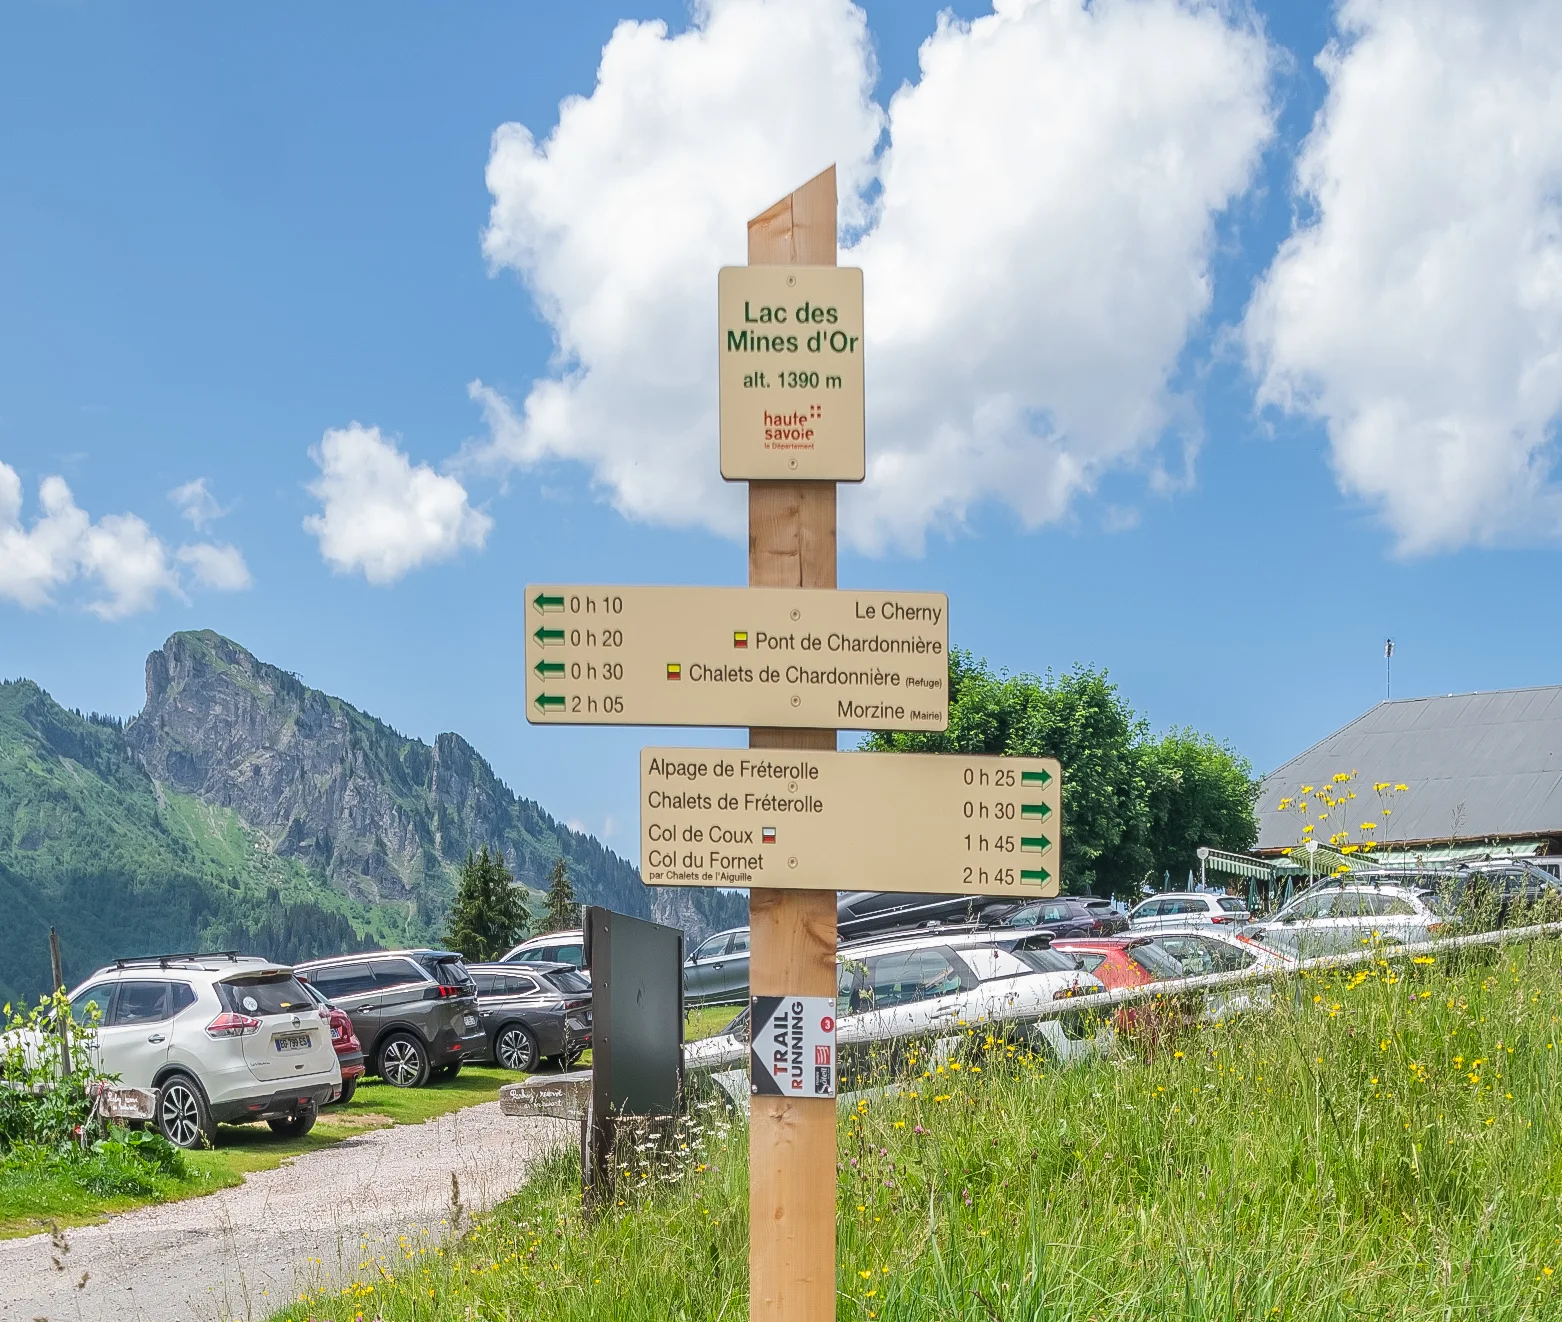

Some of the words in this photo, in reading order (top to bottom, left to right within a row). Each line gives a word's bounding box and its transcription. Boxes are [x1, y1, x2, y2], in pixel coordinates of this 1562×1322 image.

[745, 301, 787, 324] Lac
[795, 301, 838, 324] des
[727, 330, 798, 353] Mines
[807, 330, 859, 353] d'Or
[743, 371, 770, 389] alt.
[778, 372, 819, 389] 1390
[825, 375, 842, 389] m
[764, 409, 808, 426] haute
[764, 427, 814, 441] savoie
[764, 442, 770, 450] le
[570, 596, 581, 614] 0
[586, 596, 596, 614] h
[602, 596, 623, 614] 10
[855, 601, 876, 619] Le
[881, 602, 942, 626] Cherny
[570, 629, 581, 647] 0
[586, 629, 596, 647] h
[602, 629, 623, 647] 20
[756, 632, 795, 650] Pont
[800, 633, 822, 651] de
[827, 633, 942, 655] Chardonnière
[571, 663, 581, 680] 0
[587, 663, 597, 680] h
[602, 663, 624, 680] 30
[689, 664, 753, 683] Chalets
[759, 665, 780, 683] de
[786, 665, 901, 686] Chardonnière
[905, 677, 942, 689] (Refuge)
[571, 696, 582, 713] 2
[587, 696, 598, 714] h
[603, 696, 624, 714] 05
[837, 700, 905, 720] Morzine
[909, 710, 942, 722] (Mairie)
[648, 758, 708, 780] Alpage
[713, 759, 735, 778] de
[740, 760, 819, 780] Fréterolle
[963, 768, 974, 785] 0
[979, 768, 989, 786] h
[995, 769, 1016, 787] 25
[648, 791, 712, 810] Chalets
[717, 792, 739, 811] de
[744, 793, 823, 813] Fréterolle
[963, 801, 974, 818] 0
[979, 801, 989, 819] h
[994, 802, 1015, 820] 30
[648, 824, 677, 842] Col
[682, 825, 704, 843] de
[709, 825, 754, 844] Coux
[964, 834, 971, 851] 1
[979, 834, 989, 851] h
[994, 835, 1015, 853] 45
[648, 850, 677, 868] Col
[682, 851, 704, 869] du
[709, 851, 764, 871] Fornet
[649, 872, 664, 882] par
[666, 871, 700, 882] Chalets
[701, 871, 713, 881] de
[715, 872, 753, 884] l'Aiguille
[963, 867, 973, 884] 2
[979, 867, 988, 884] h
[994, 868, 1015, 885] 45
[824, 1019, 831, 1030] 3
[773, 1011, 788, 1076] TRAIL
[791, 1001, 804, 1090] RUNNING
